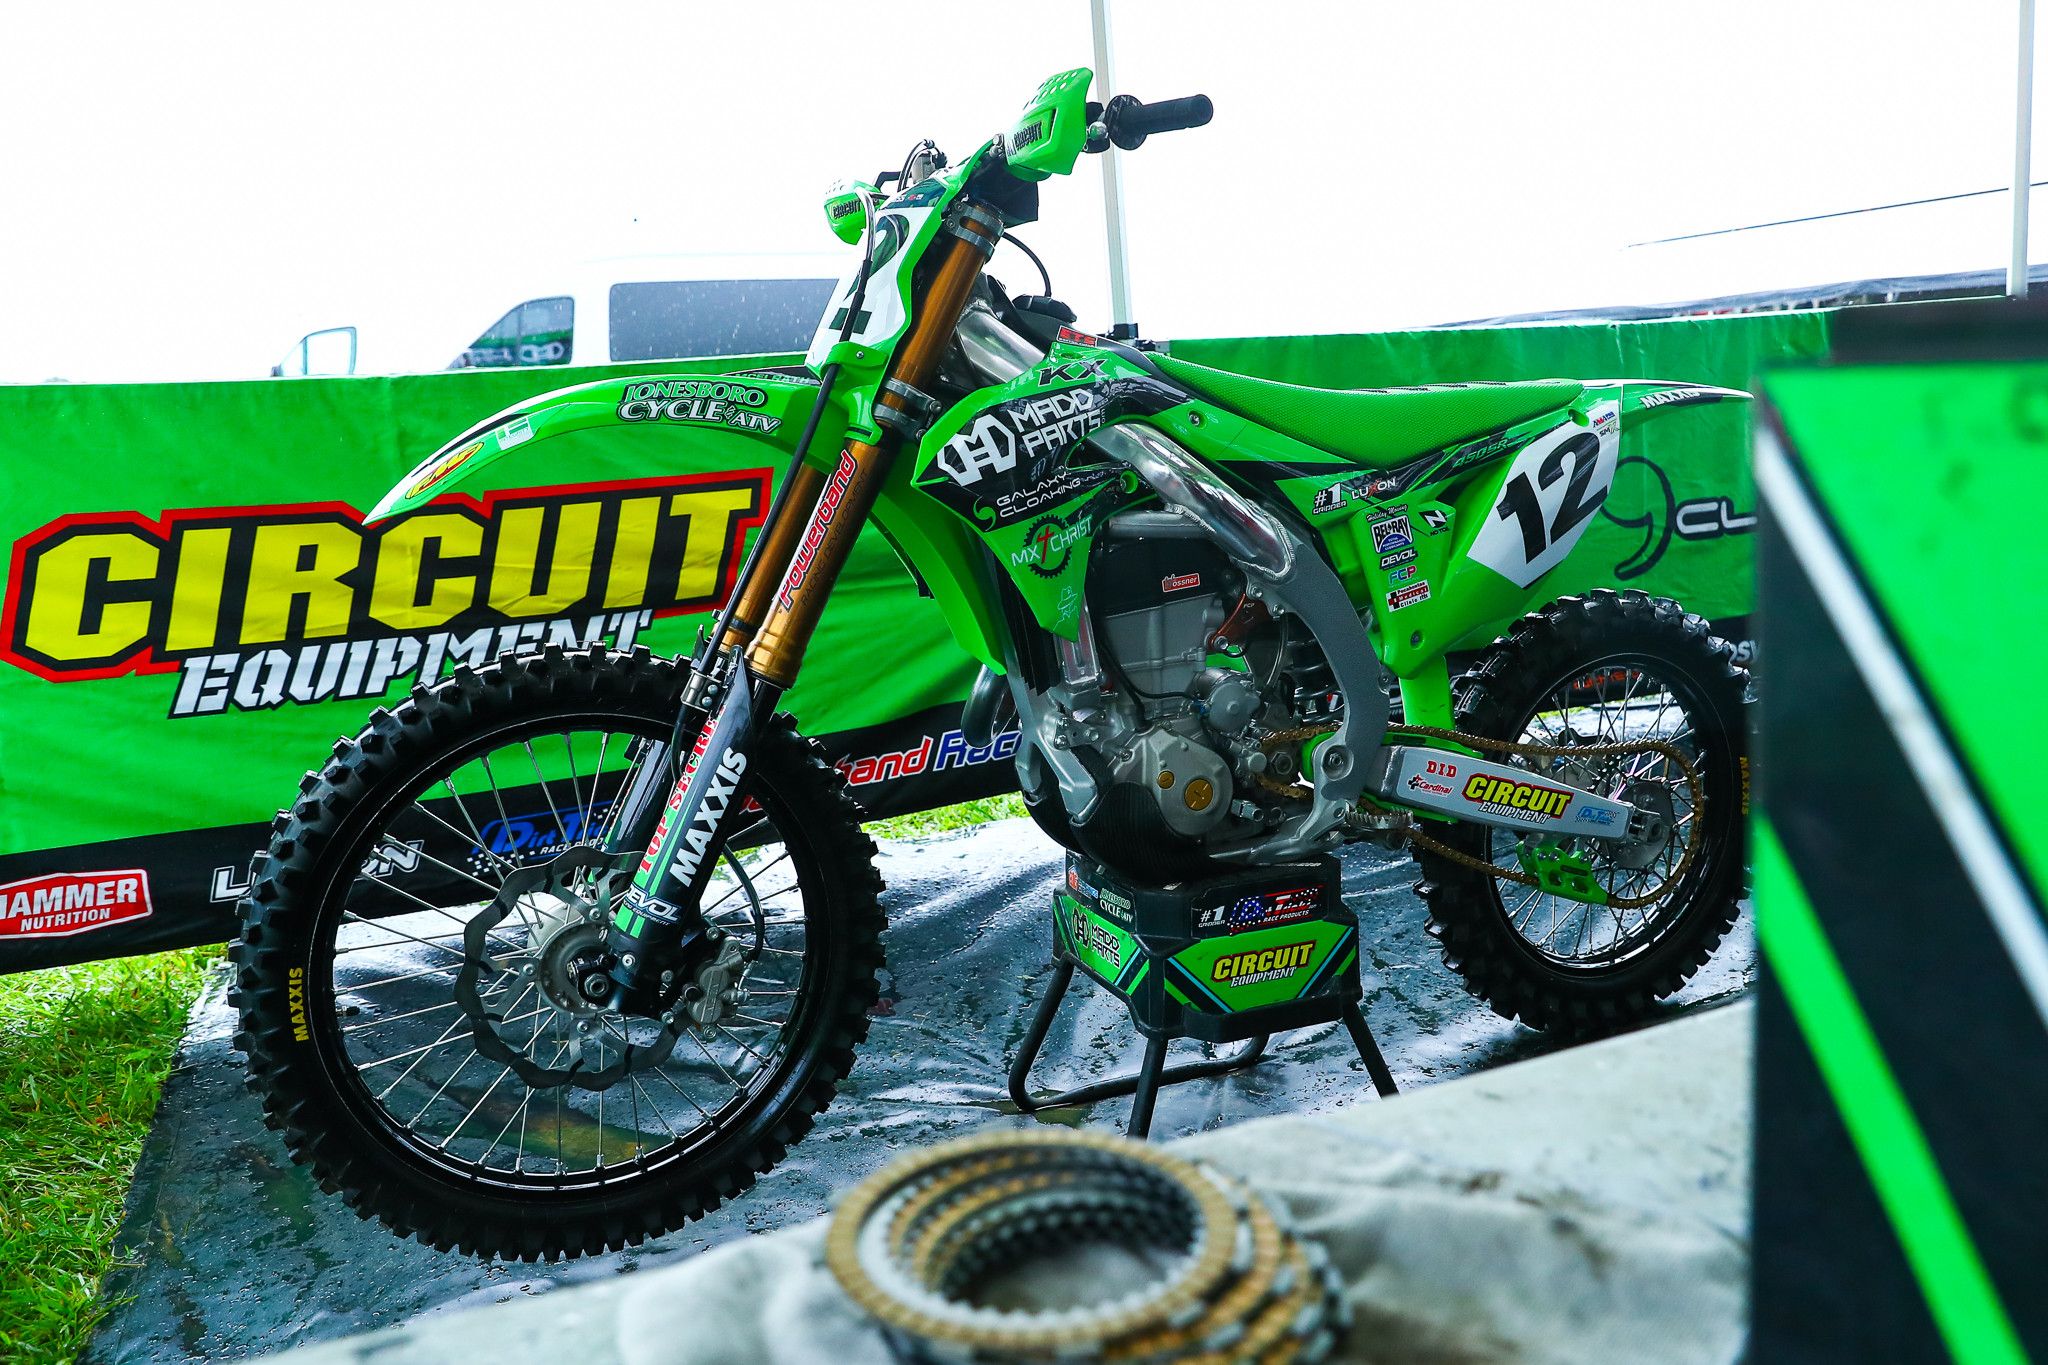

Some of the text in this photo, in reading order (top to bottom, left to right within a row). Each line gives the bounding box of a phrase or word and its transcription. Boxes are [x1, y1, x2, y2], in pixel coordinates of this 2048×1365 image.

[832, 199, 863, 219] CIRCUIT
[1037, 358, 1111, 387] KX
[624, 381, 766, 407] JONESBORO
[1007, 388, 1094, 433] MADD
[1639, 391, 1701, 409] MAXXIS
[620, 399, 727, 422] CYCLE
[729, 411, 780, 433] ATV
[1022, 408, 1102, 458] PARTS
[996, 471, 1072, 507] GALAXY
[999, 478, 1082, 518] CLOAKING
[1314, 478, 1397, 508] #1 LUXON
[1496, 432, 1608, 565] 12
[779, 450, 857, 610] Powerband
[800, 467, 870, 607] RACING DEVELOPMENT
[25, 487, 754, 662] CIRCUIT
[1381, 549, 1416, 567] DEVOL
[1388, 565, 1417, 585] FCP
[173, 608, 653, 715] EQUIPMENT
[1418, 780, 1454, 795] Cardinal
[1464, 775, 1573, 817] CIRCUIT
[669, 746, 748, 888] MAXXIS
[1478, 801, 1552, 825] EQUIPMENT
[637, 814, 670, 875] TOP
[20, 906, 111, 932] NUTRITION
[1100, 899, 1122, 918] CYCLE
[1200, 905, 1226, 923] #1
[1262, 914, 1279, 923] RACE
[1279, 909, 1310, 921] PRODUCTS
[1091, 920, 1121, 952] MADD
[1213, 943, 1314, 981] CIRCUIT
[1230, 966, 1298, 988] EQUIPMENT
[288, 967, 310, 1042] MAXXIS
